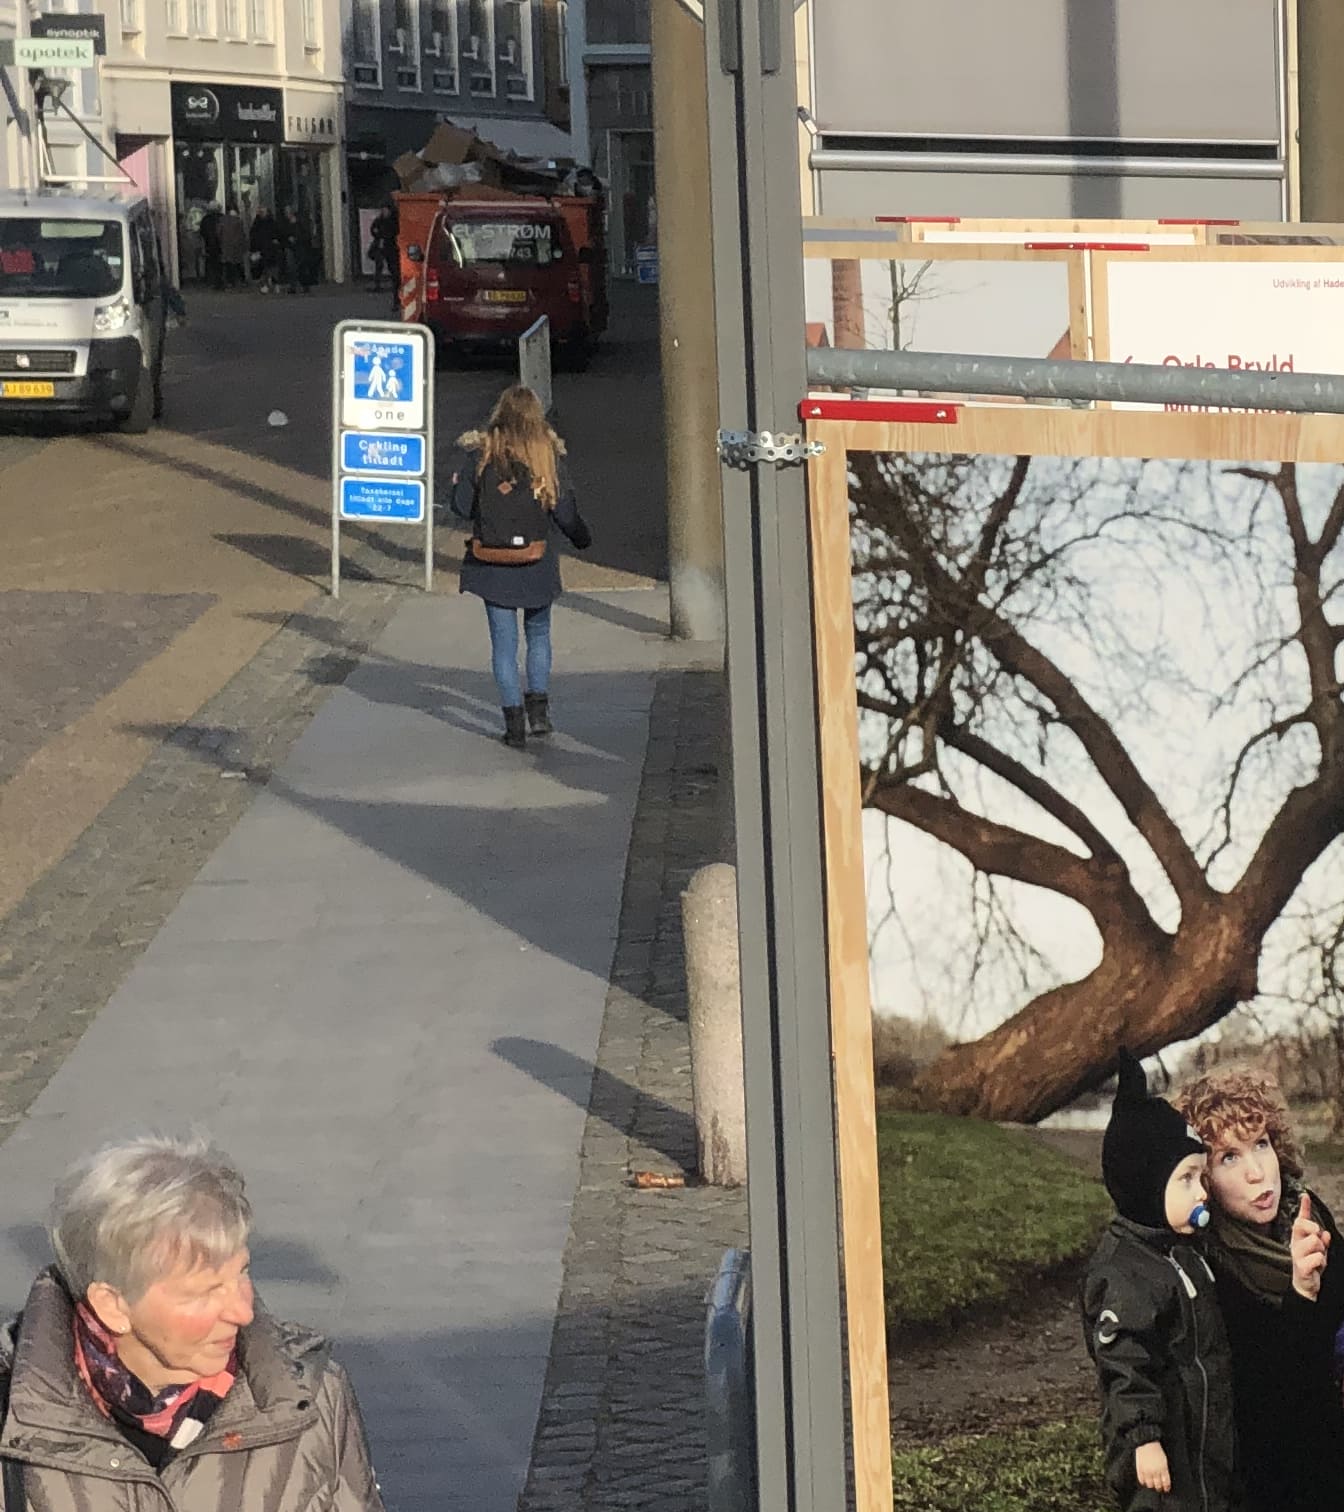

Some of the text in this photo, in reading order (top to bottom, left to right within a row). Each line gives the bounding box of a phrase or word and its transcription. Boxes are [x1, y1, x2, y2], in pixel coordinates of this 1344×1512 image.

[20, 45, 89, 62] apotek
[287, 115, 334, 135] FRISØR
[1272, 278, 1311, 291] Udvikling
